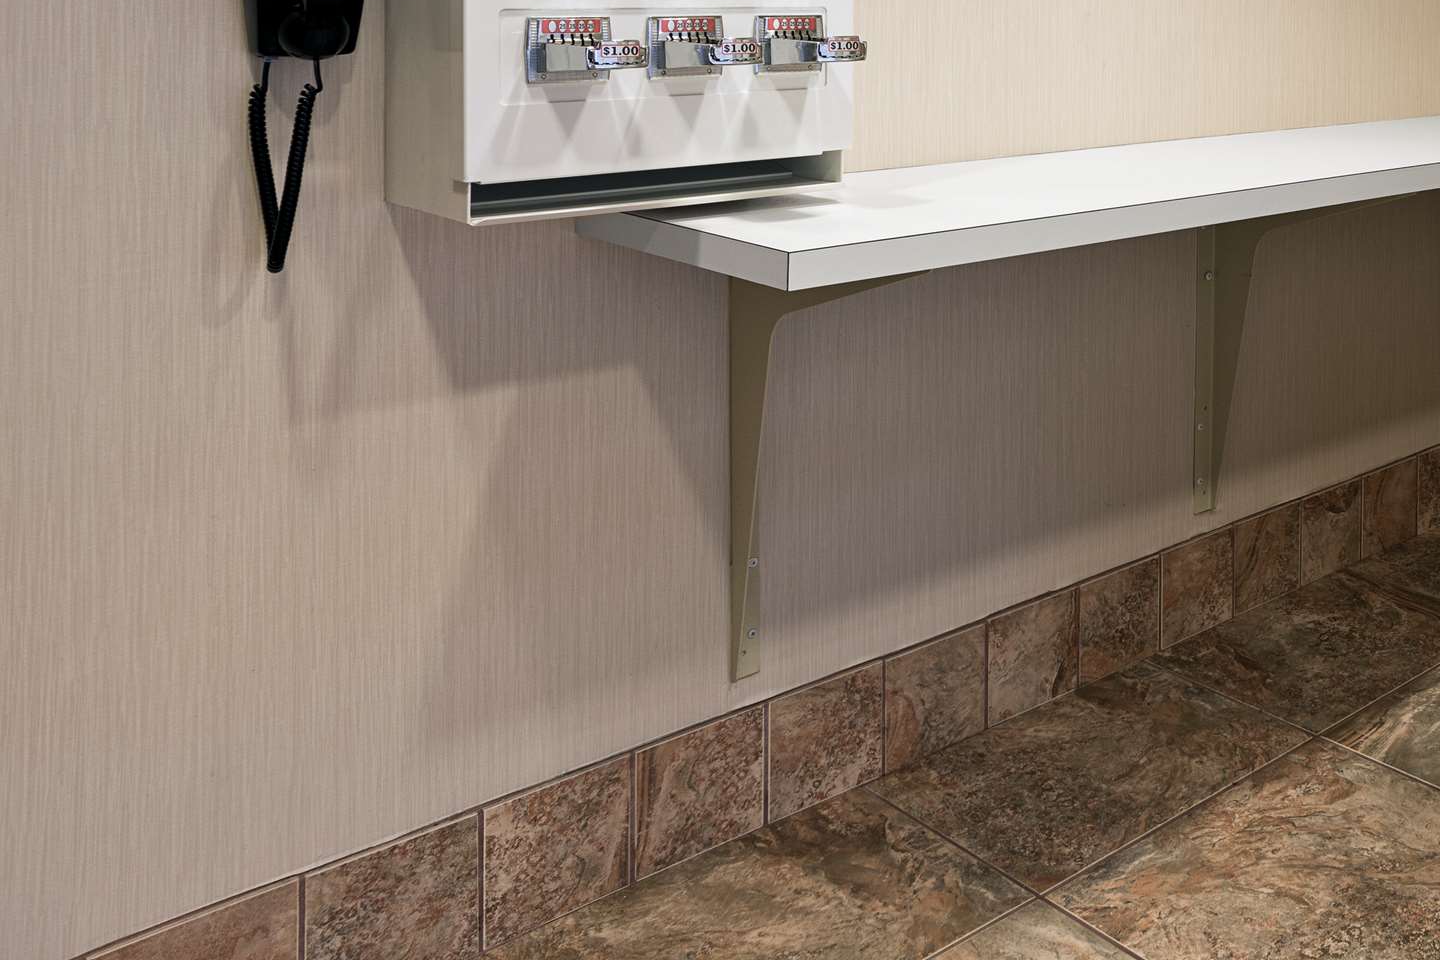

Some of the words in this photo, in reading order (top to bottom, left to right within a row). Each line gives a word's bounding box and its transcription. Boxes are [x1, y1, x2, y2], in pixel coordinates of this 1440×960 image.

[602, 46, 639, 57] $1.00
[723, 43, 756, 54] $1.00
[830, 41, 859, 51] $1.00
